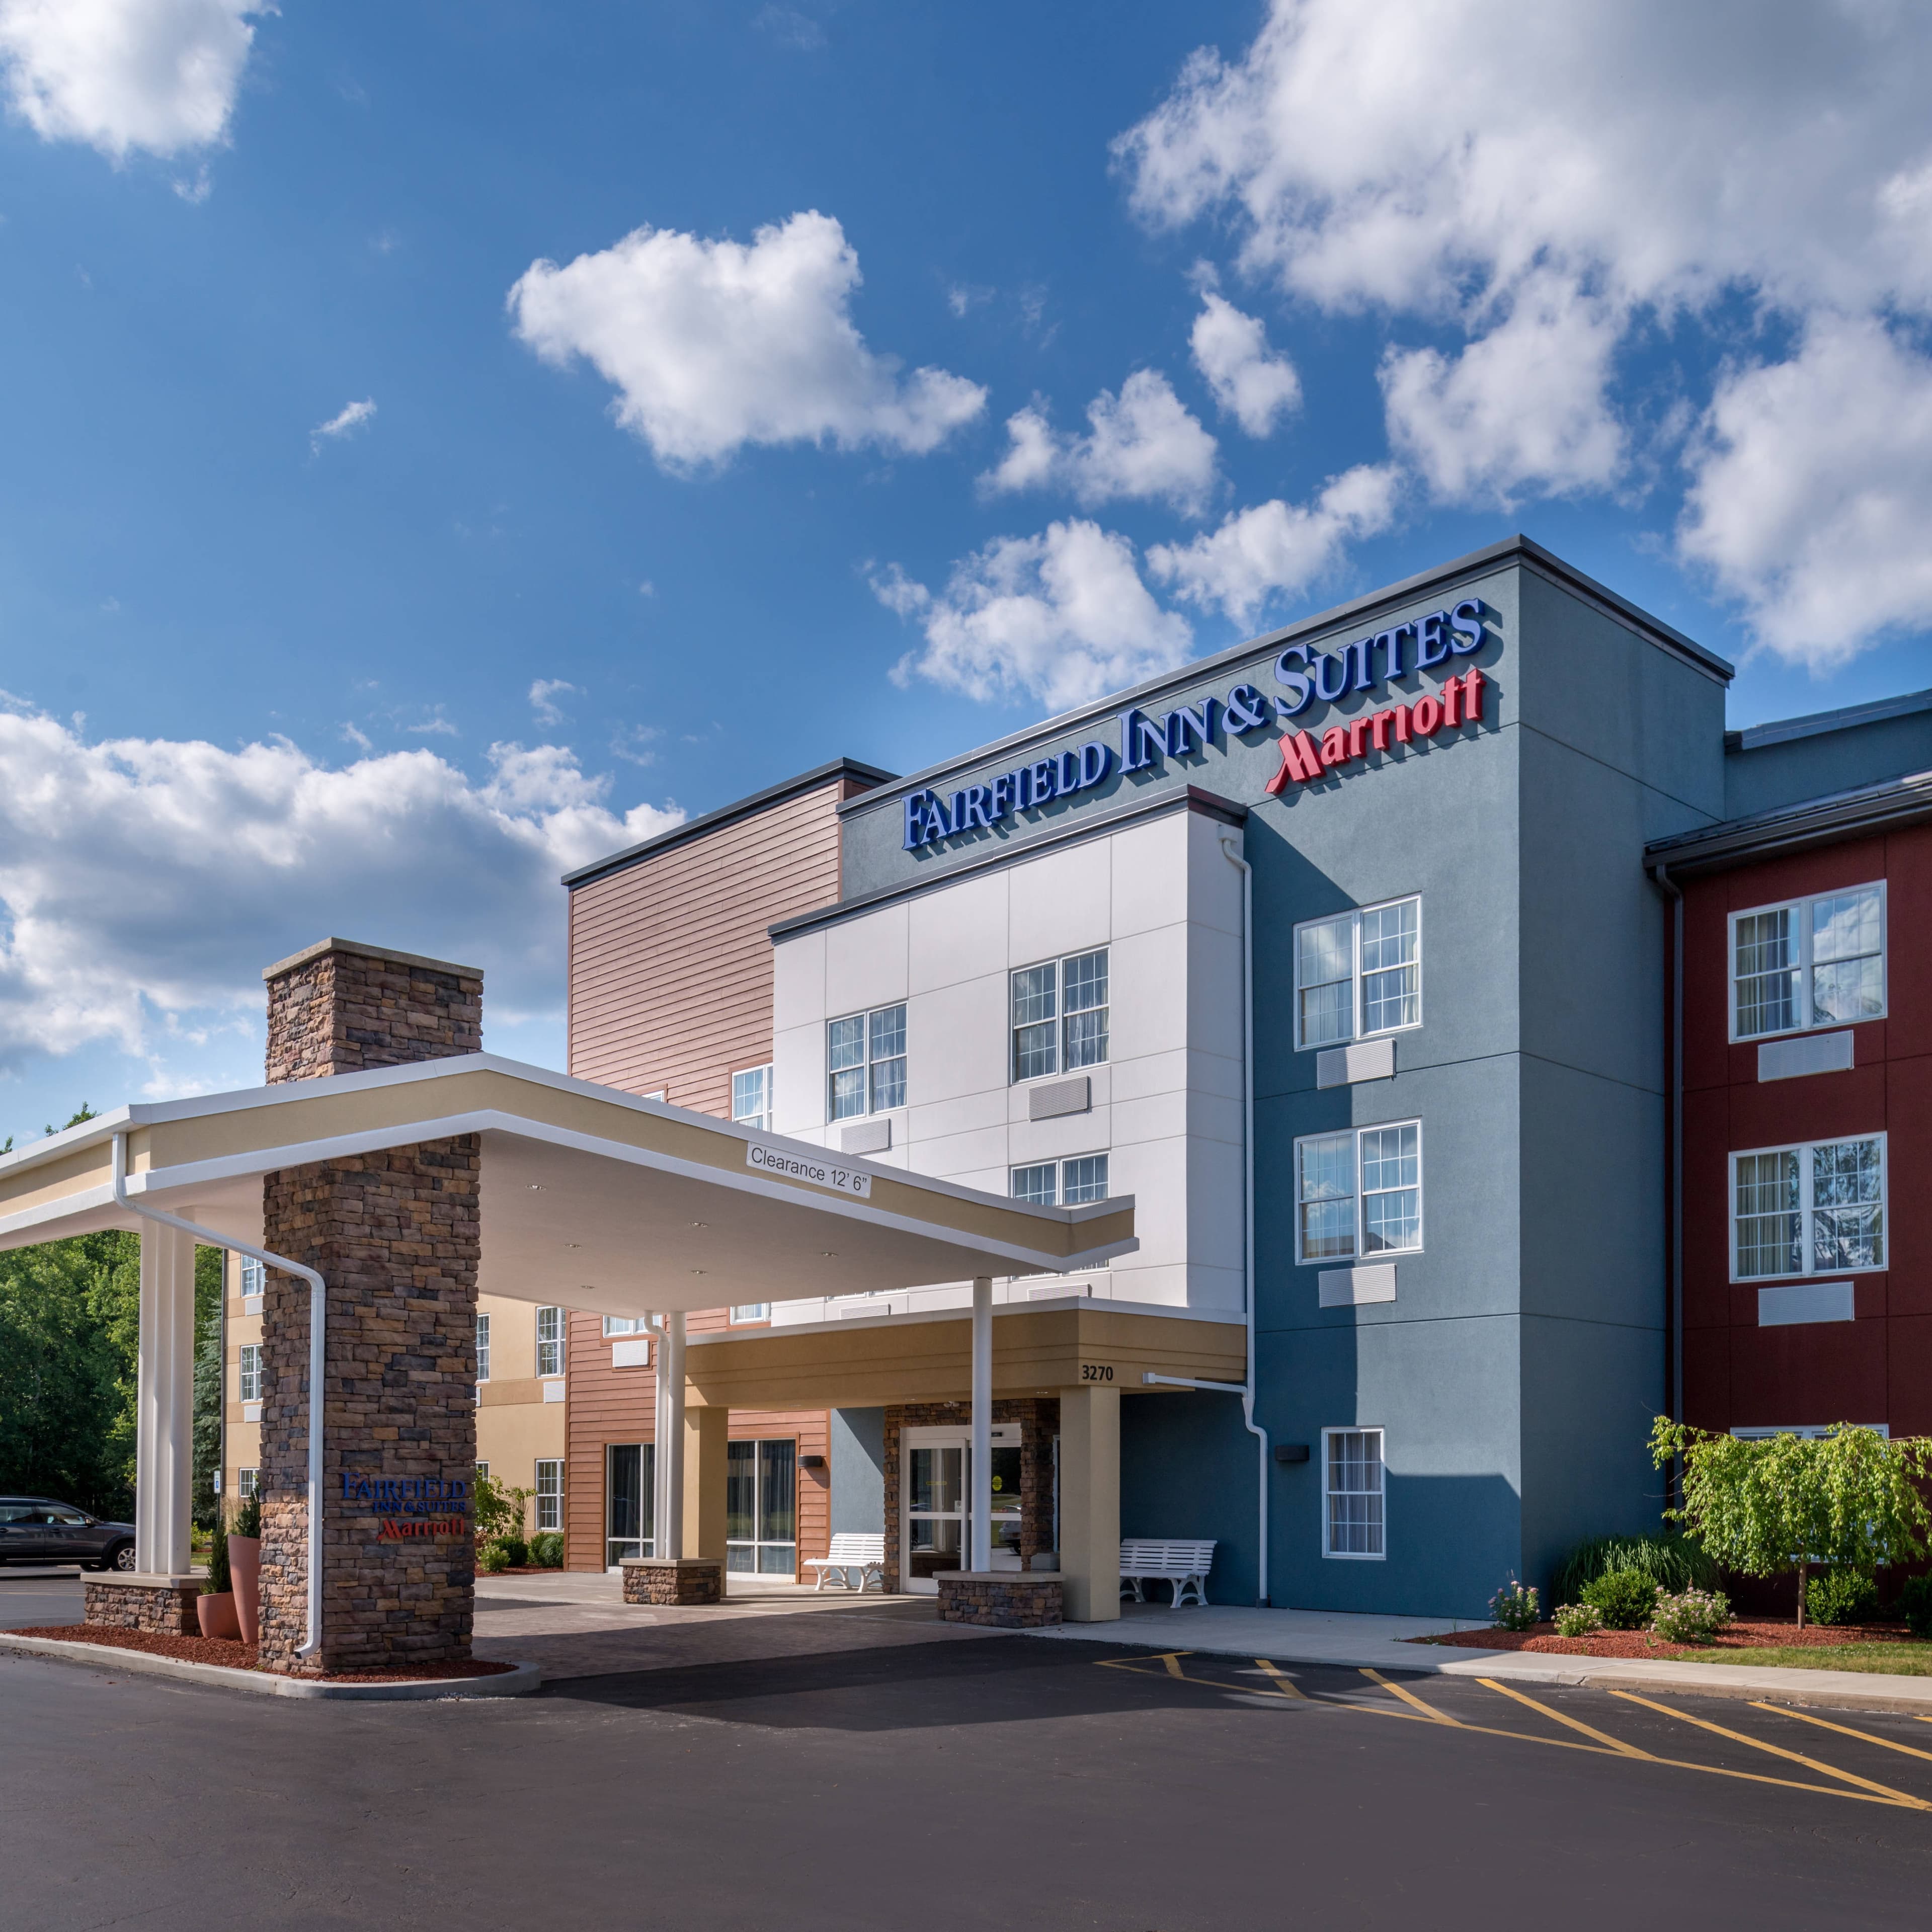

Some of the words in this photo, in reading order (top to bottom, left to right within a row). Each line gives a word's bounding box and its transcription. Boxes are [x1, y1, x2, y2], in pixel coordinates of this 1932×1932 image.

[901, 741, 1109, 851] FAIRFIELD
[1273, 598, 1486, 716] SUITES
[1265, 668, 1486, 794] Marriott
[752, 1148, 825, 1180] Clearance
[1083, 1365, 1113, 1381] 3270
[342, 1473, 466, 1501] FAIRFIELD
[417, 1501, 466, 1512] SUITES
[377, 1518, 465, 1541] Marriott
